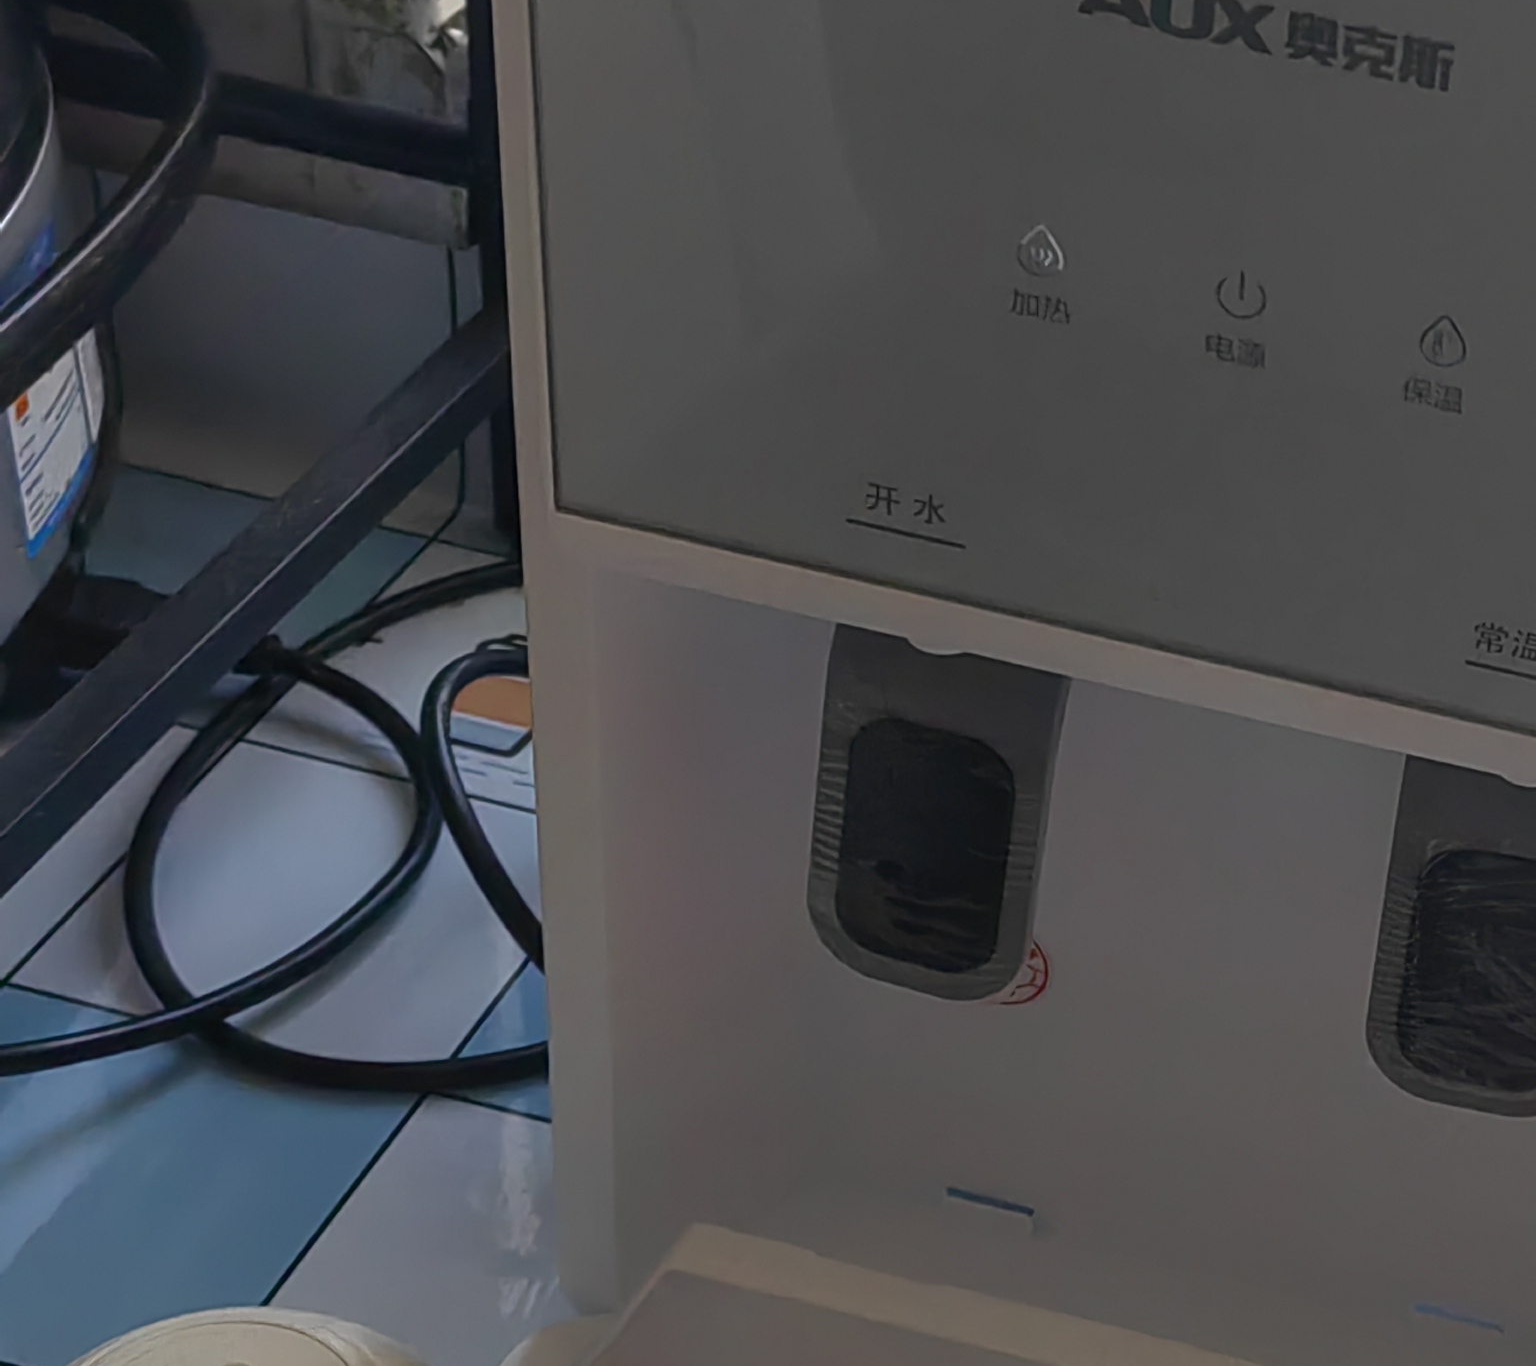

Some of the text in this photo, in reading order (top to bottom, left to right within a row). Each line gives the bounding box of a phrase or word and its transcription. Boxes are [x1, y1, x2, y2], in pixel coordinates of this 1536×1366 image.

[1285, 10, 1455, 92] 奥克斯
[1010, 288, 1071, 324] 加热
[1205, 334, 1266, 370] 电源
[1403, 377, 1464, 415] 保温
[866, 482, 946, 524] 开水
